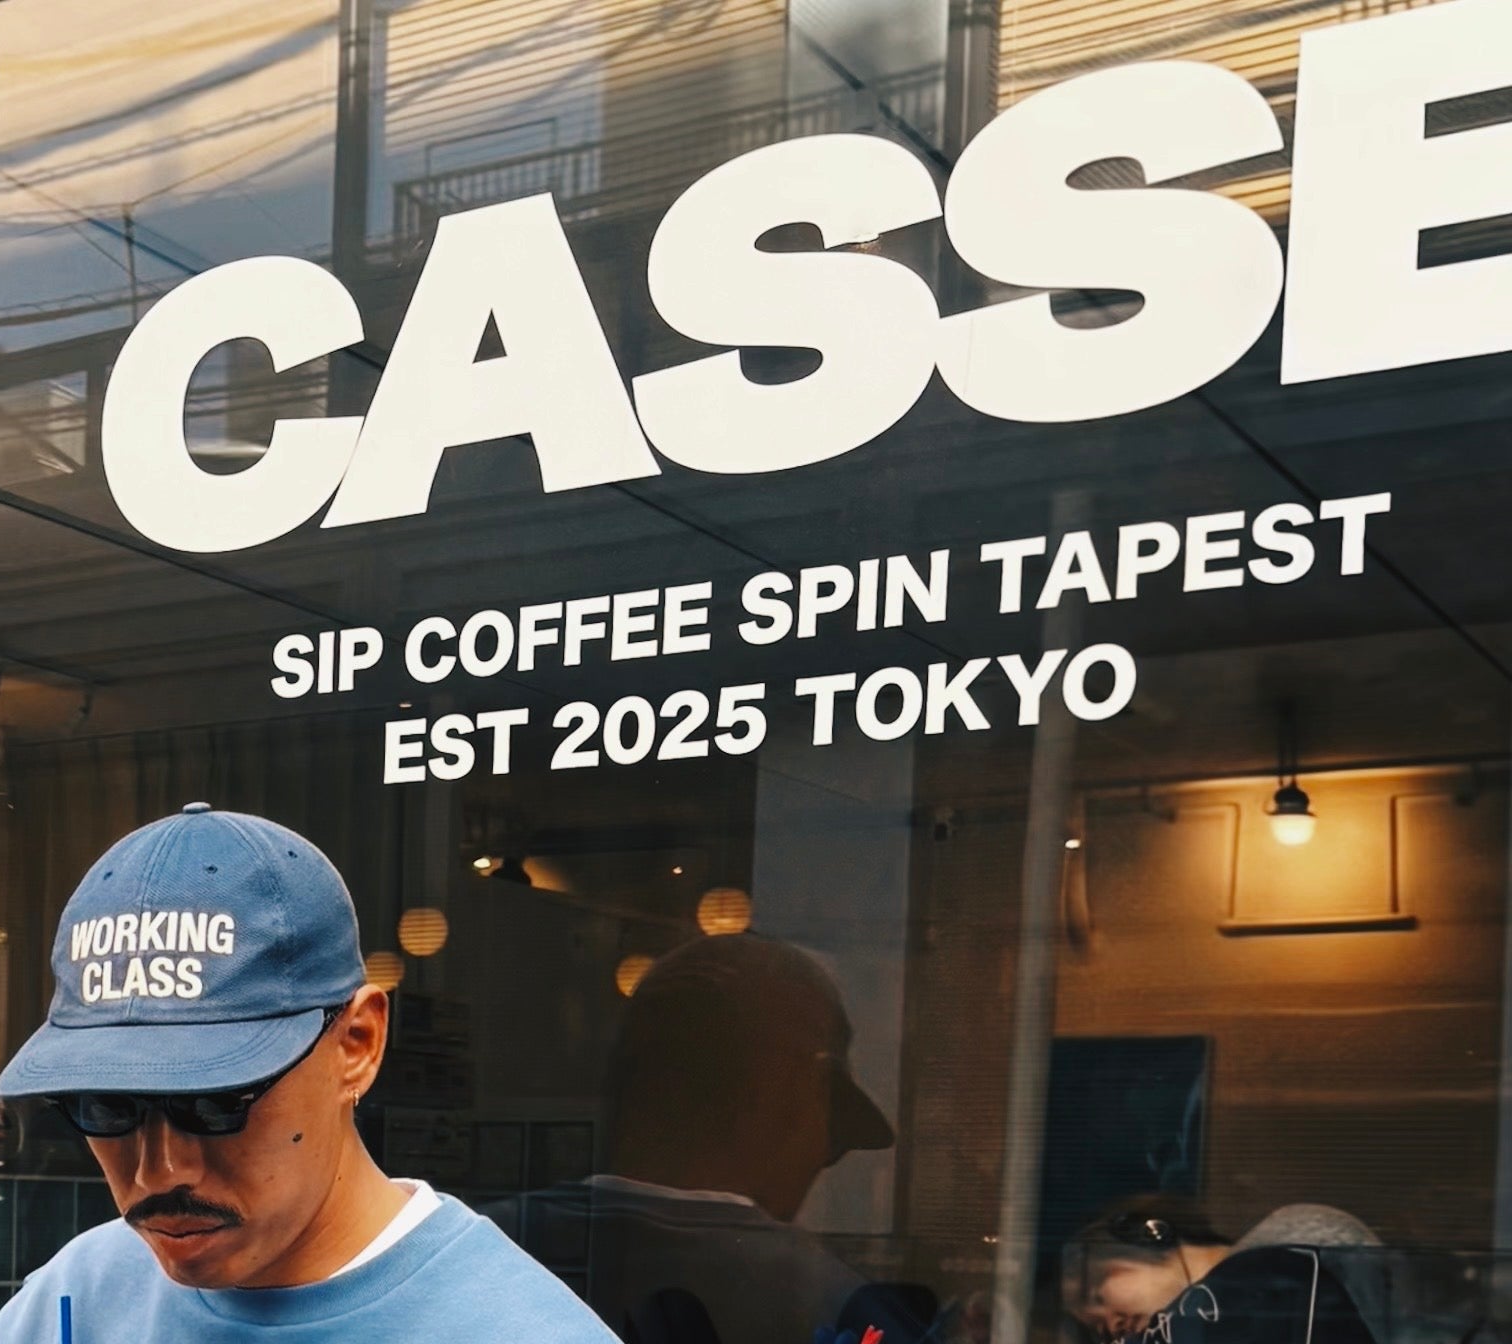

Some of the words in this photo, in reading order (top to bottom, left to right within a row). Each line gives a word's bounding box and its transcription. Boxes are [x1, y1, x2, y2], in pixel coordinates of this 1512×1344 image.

[101, 0, 1512, 553] CASSE
[271, 626, 383, 698] SIP
[405, 580, 713, 684] COFFEE
[738, 548, 951, 646] SPIN
[979, 491, 1392, 615] TAPEST
[383, 707, 530, 785] EST
[550, 682, 768, 770] 2025
[795, 642, 1138, 747] TOKYO
[70, 909, 236, 962] WORKING
[82, 955, 204, 1003] CLASS
